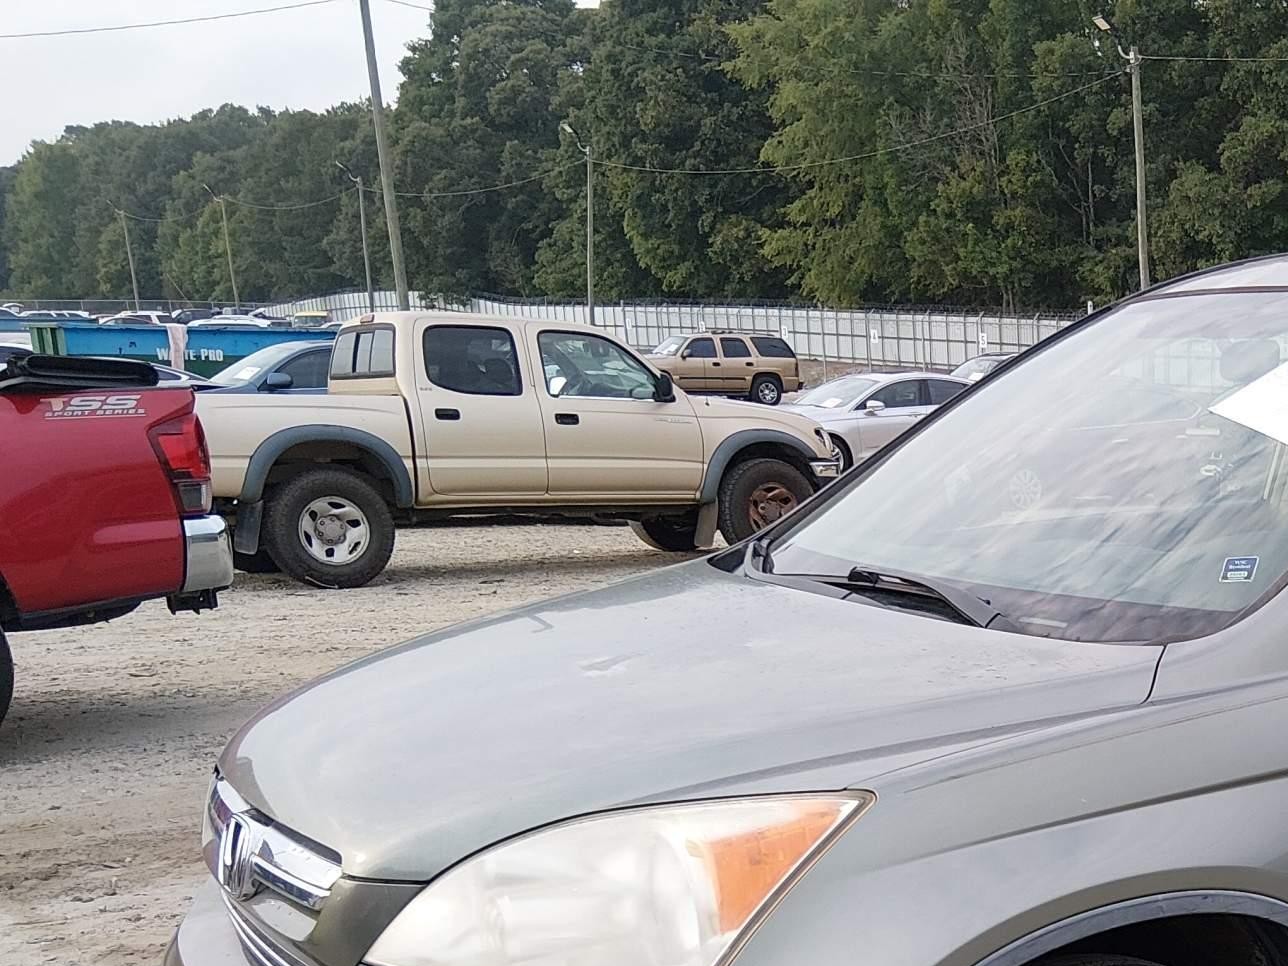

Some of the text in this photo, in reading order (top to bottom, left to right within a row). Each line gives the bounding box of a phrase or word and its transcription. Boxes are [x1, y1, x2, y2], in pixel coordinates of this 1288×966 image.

[156, 348, 224, 362] WTE PRO
[44, 408, 146, 418] SPORT SERIES
